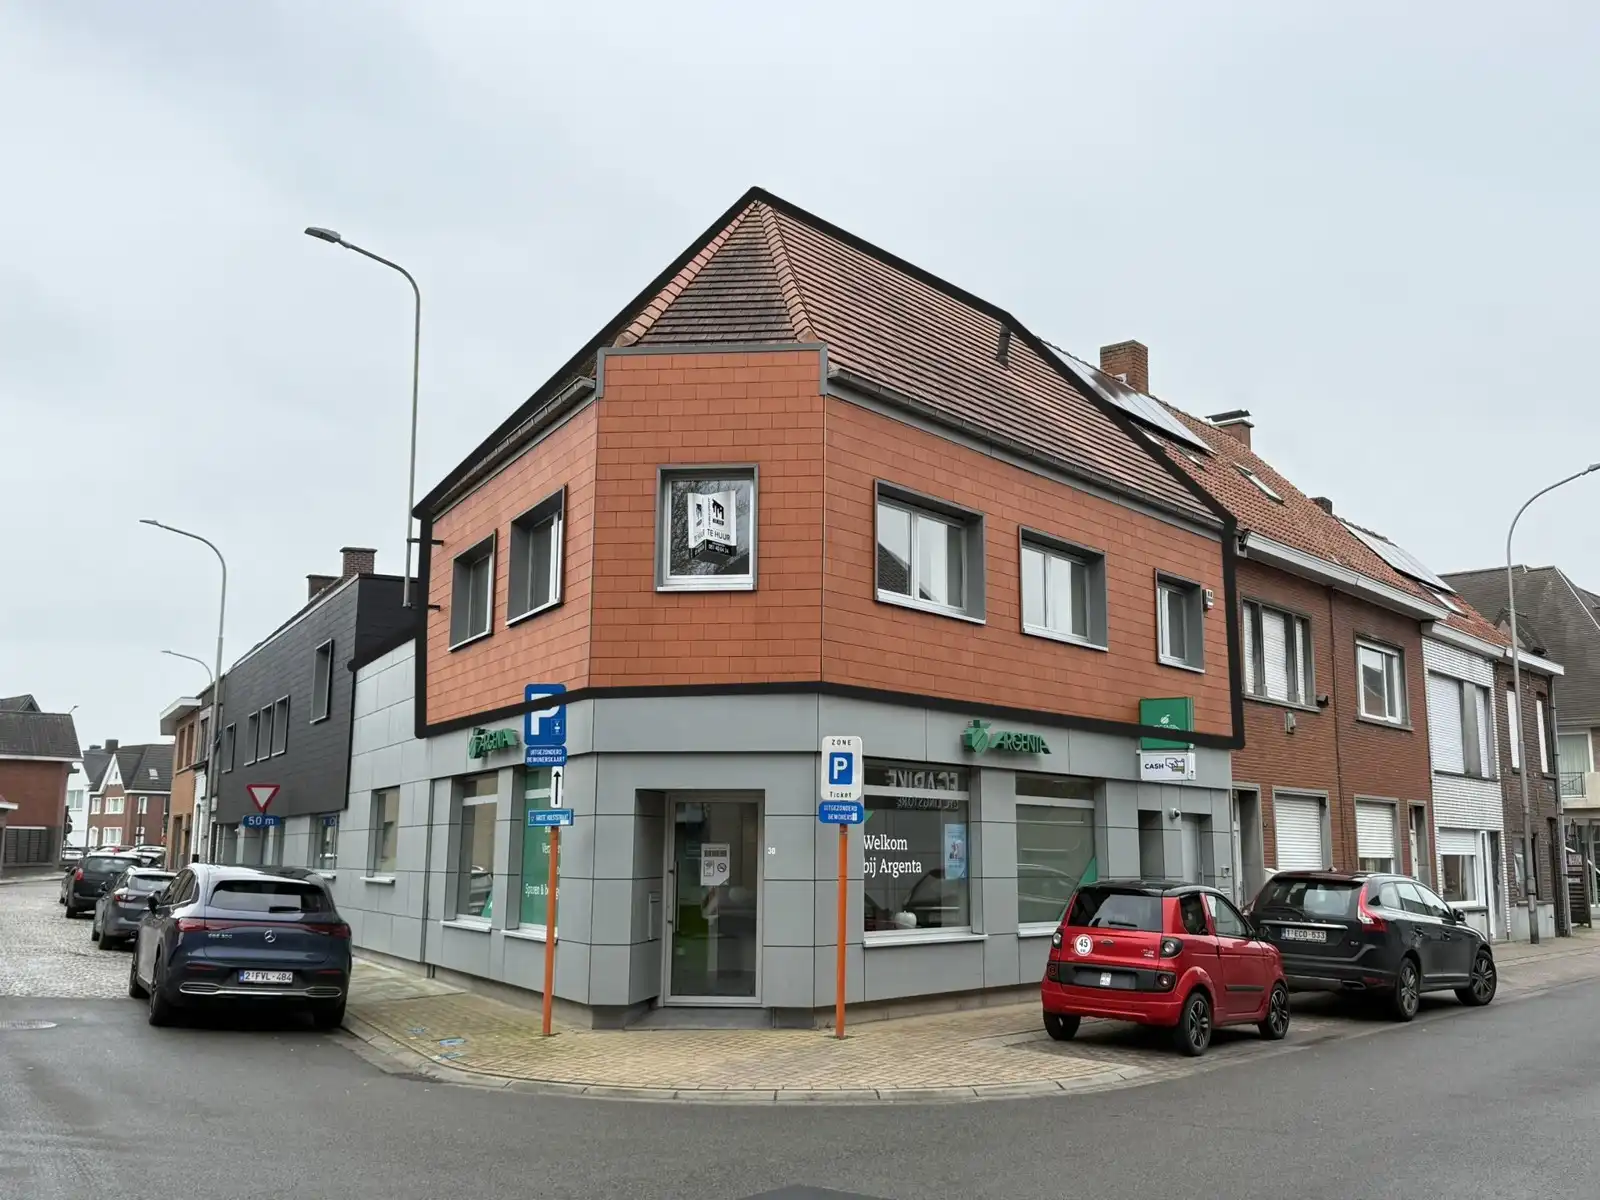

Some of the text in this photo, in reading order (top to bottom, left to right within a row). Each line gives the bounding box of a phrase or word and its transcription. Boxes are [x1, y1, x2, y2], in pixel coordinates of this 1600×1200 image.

[707, 529, 713, 537] TE
[715, 530, 730, 540] HUUR
[988, 730, 1052, 755] ARGENTA
[833, 757, 848, 780] P
[248, 816, 262, 825] 50
[864, 834, 908, 850] Welkom
[879, 858, 922, 878] Argenta
[1079, 938, 1088, 948] 45
